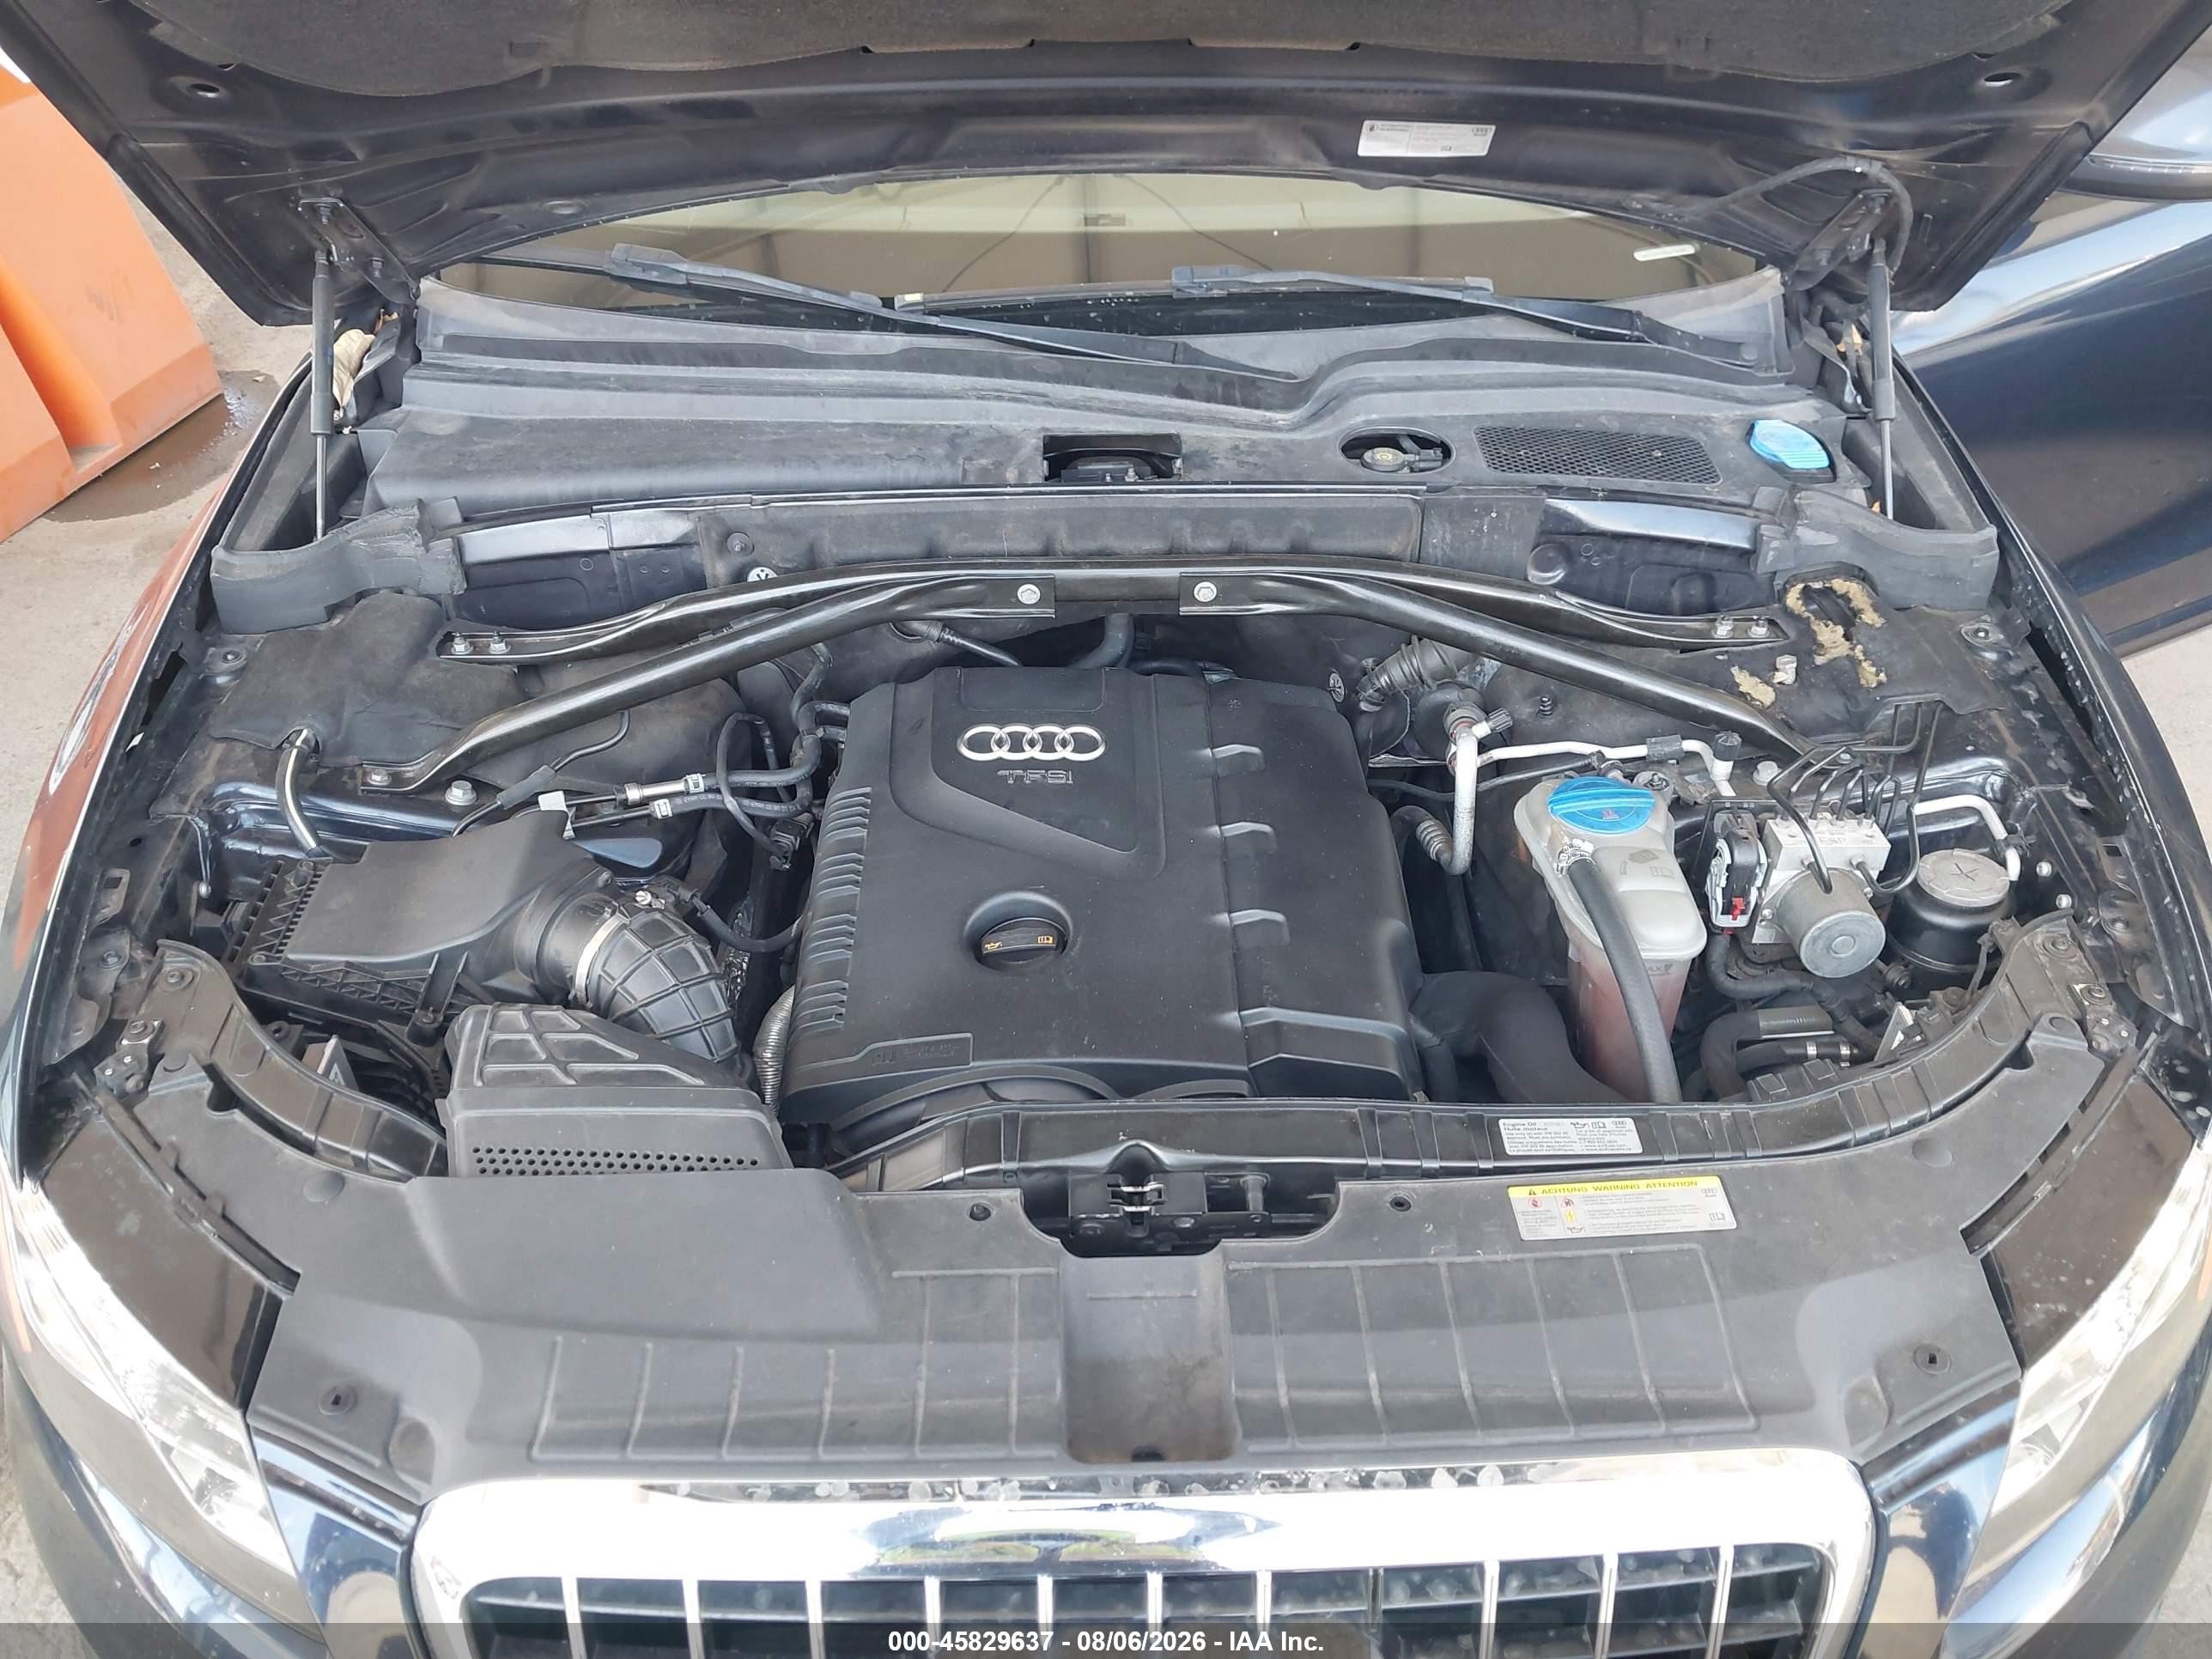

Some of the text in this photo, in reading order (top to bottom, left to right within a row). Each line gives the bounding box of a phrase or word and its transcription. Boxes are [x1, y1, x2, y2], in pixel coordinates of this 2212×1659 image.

[997, 769, 1073, 784] TFSI
[1541, 1181, 1698, 1195] ACHTUNG WARNING ATTENTION
